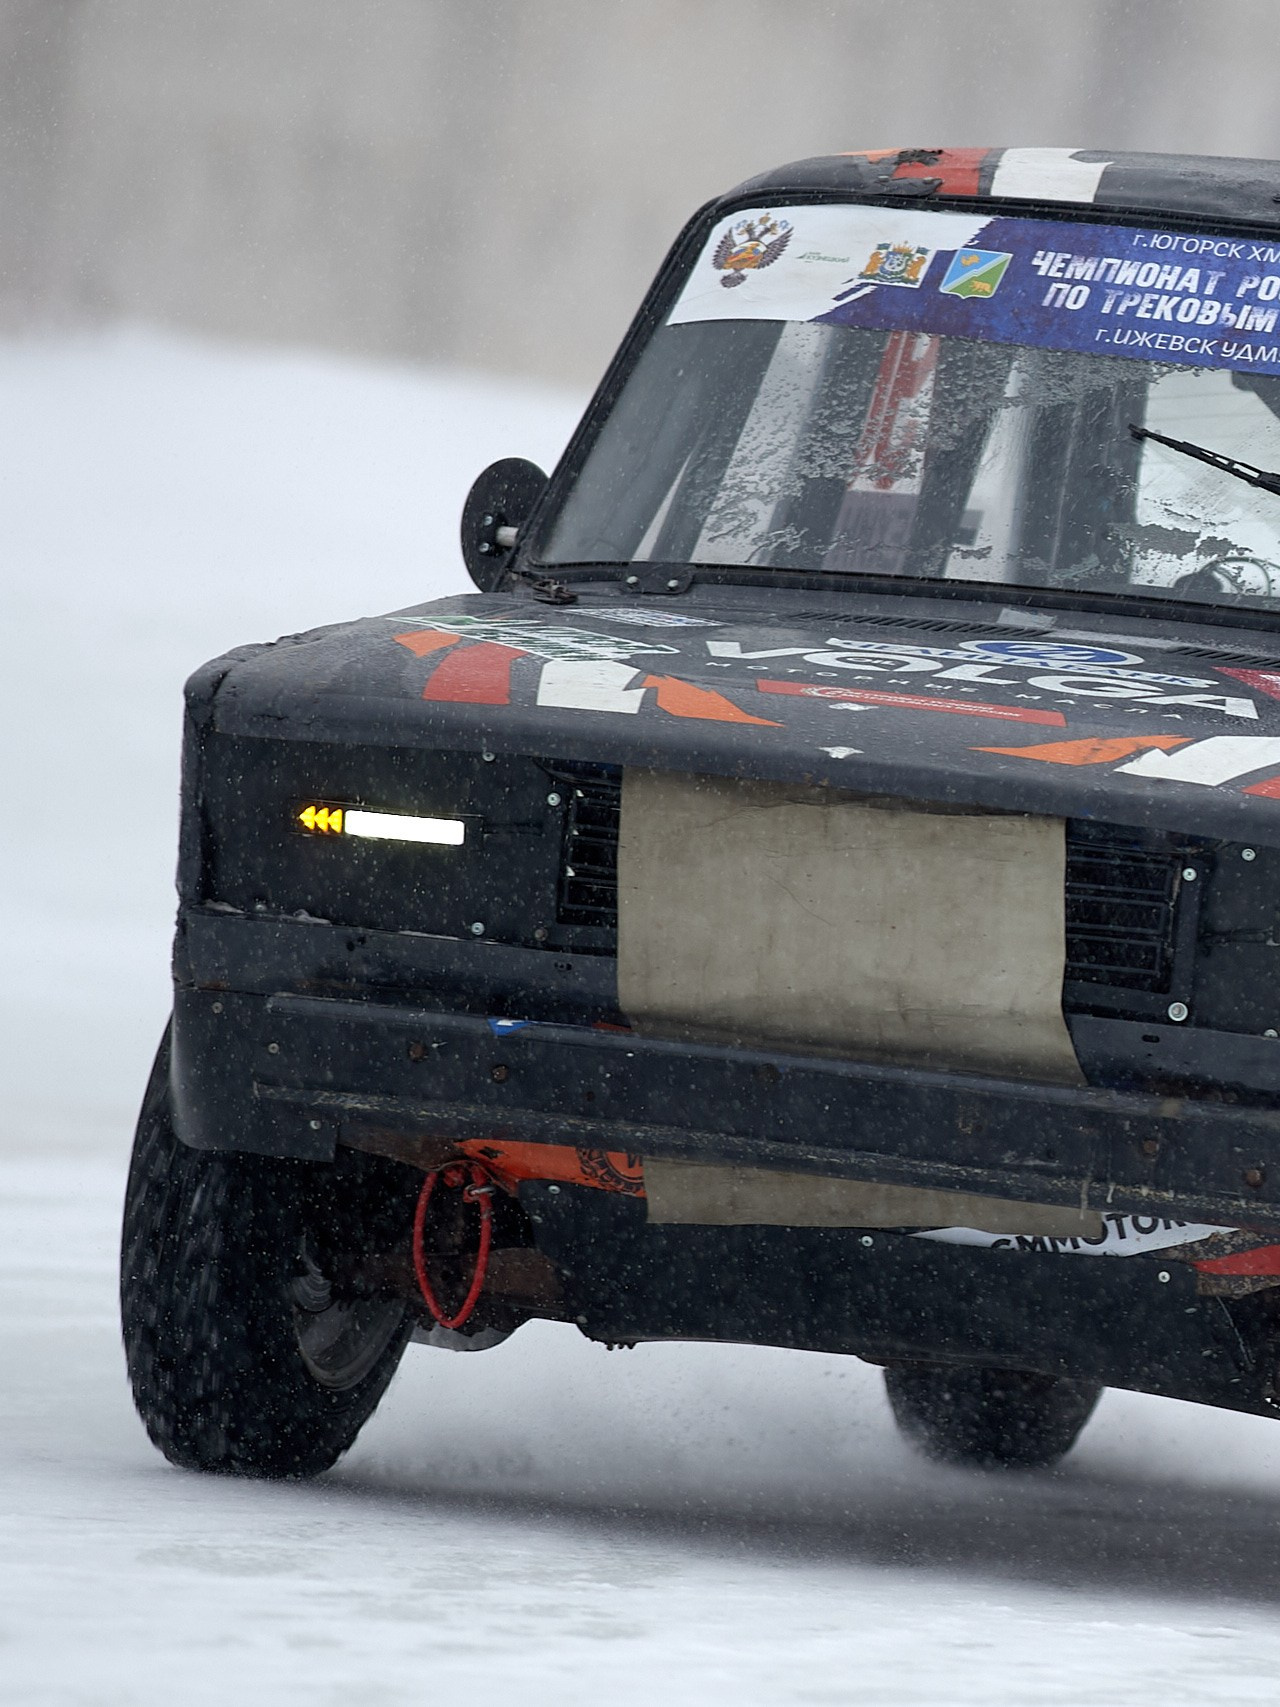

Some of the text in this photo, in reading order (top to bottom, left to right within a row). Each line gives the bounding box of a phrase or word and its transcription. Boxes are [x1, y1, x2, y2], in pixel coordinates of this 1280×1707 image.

[1132, 233, 1246, 259] г.ЮГОРСК
[1032, 250, 1226, 297] ЧЕМПИОНАТ
[1041, 282, 1091, 311] ПО
[1103, 288, 1279, 334] ТРЕКОВЫМ
[1094, 327, 1219, 357] г.ИЖЕВСК
[704, 661, 1185, 721] МОТОРНЫЕ МАСЛА
[706, 640, 1260, 720] VOLGA
